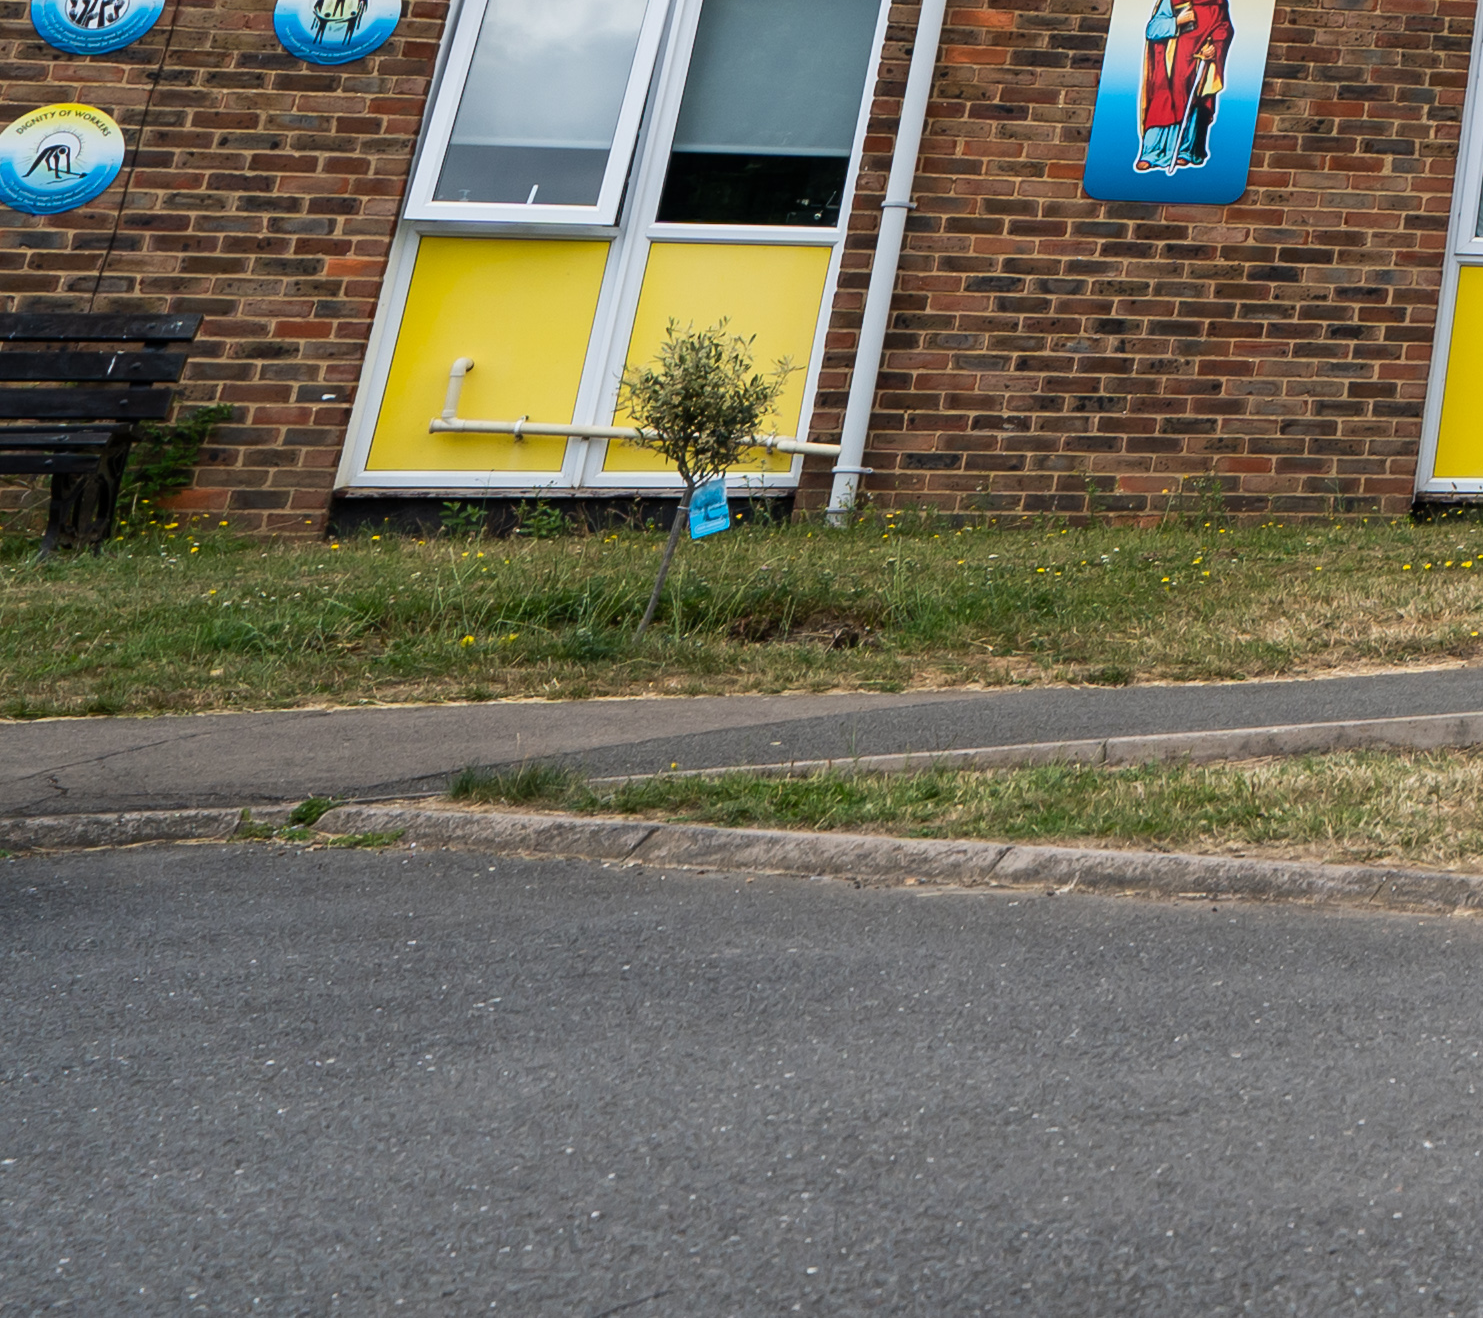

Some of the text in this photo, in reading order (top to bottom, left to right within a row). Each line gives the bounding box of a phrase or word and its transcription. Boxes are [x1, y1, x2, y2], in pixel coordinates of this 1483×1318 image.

[16, 109, 112, 137] DIGNITY OF WORKERS
